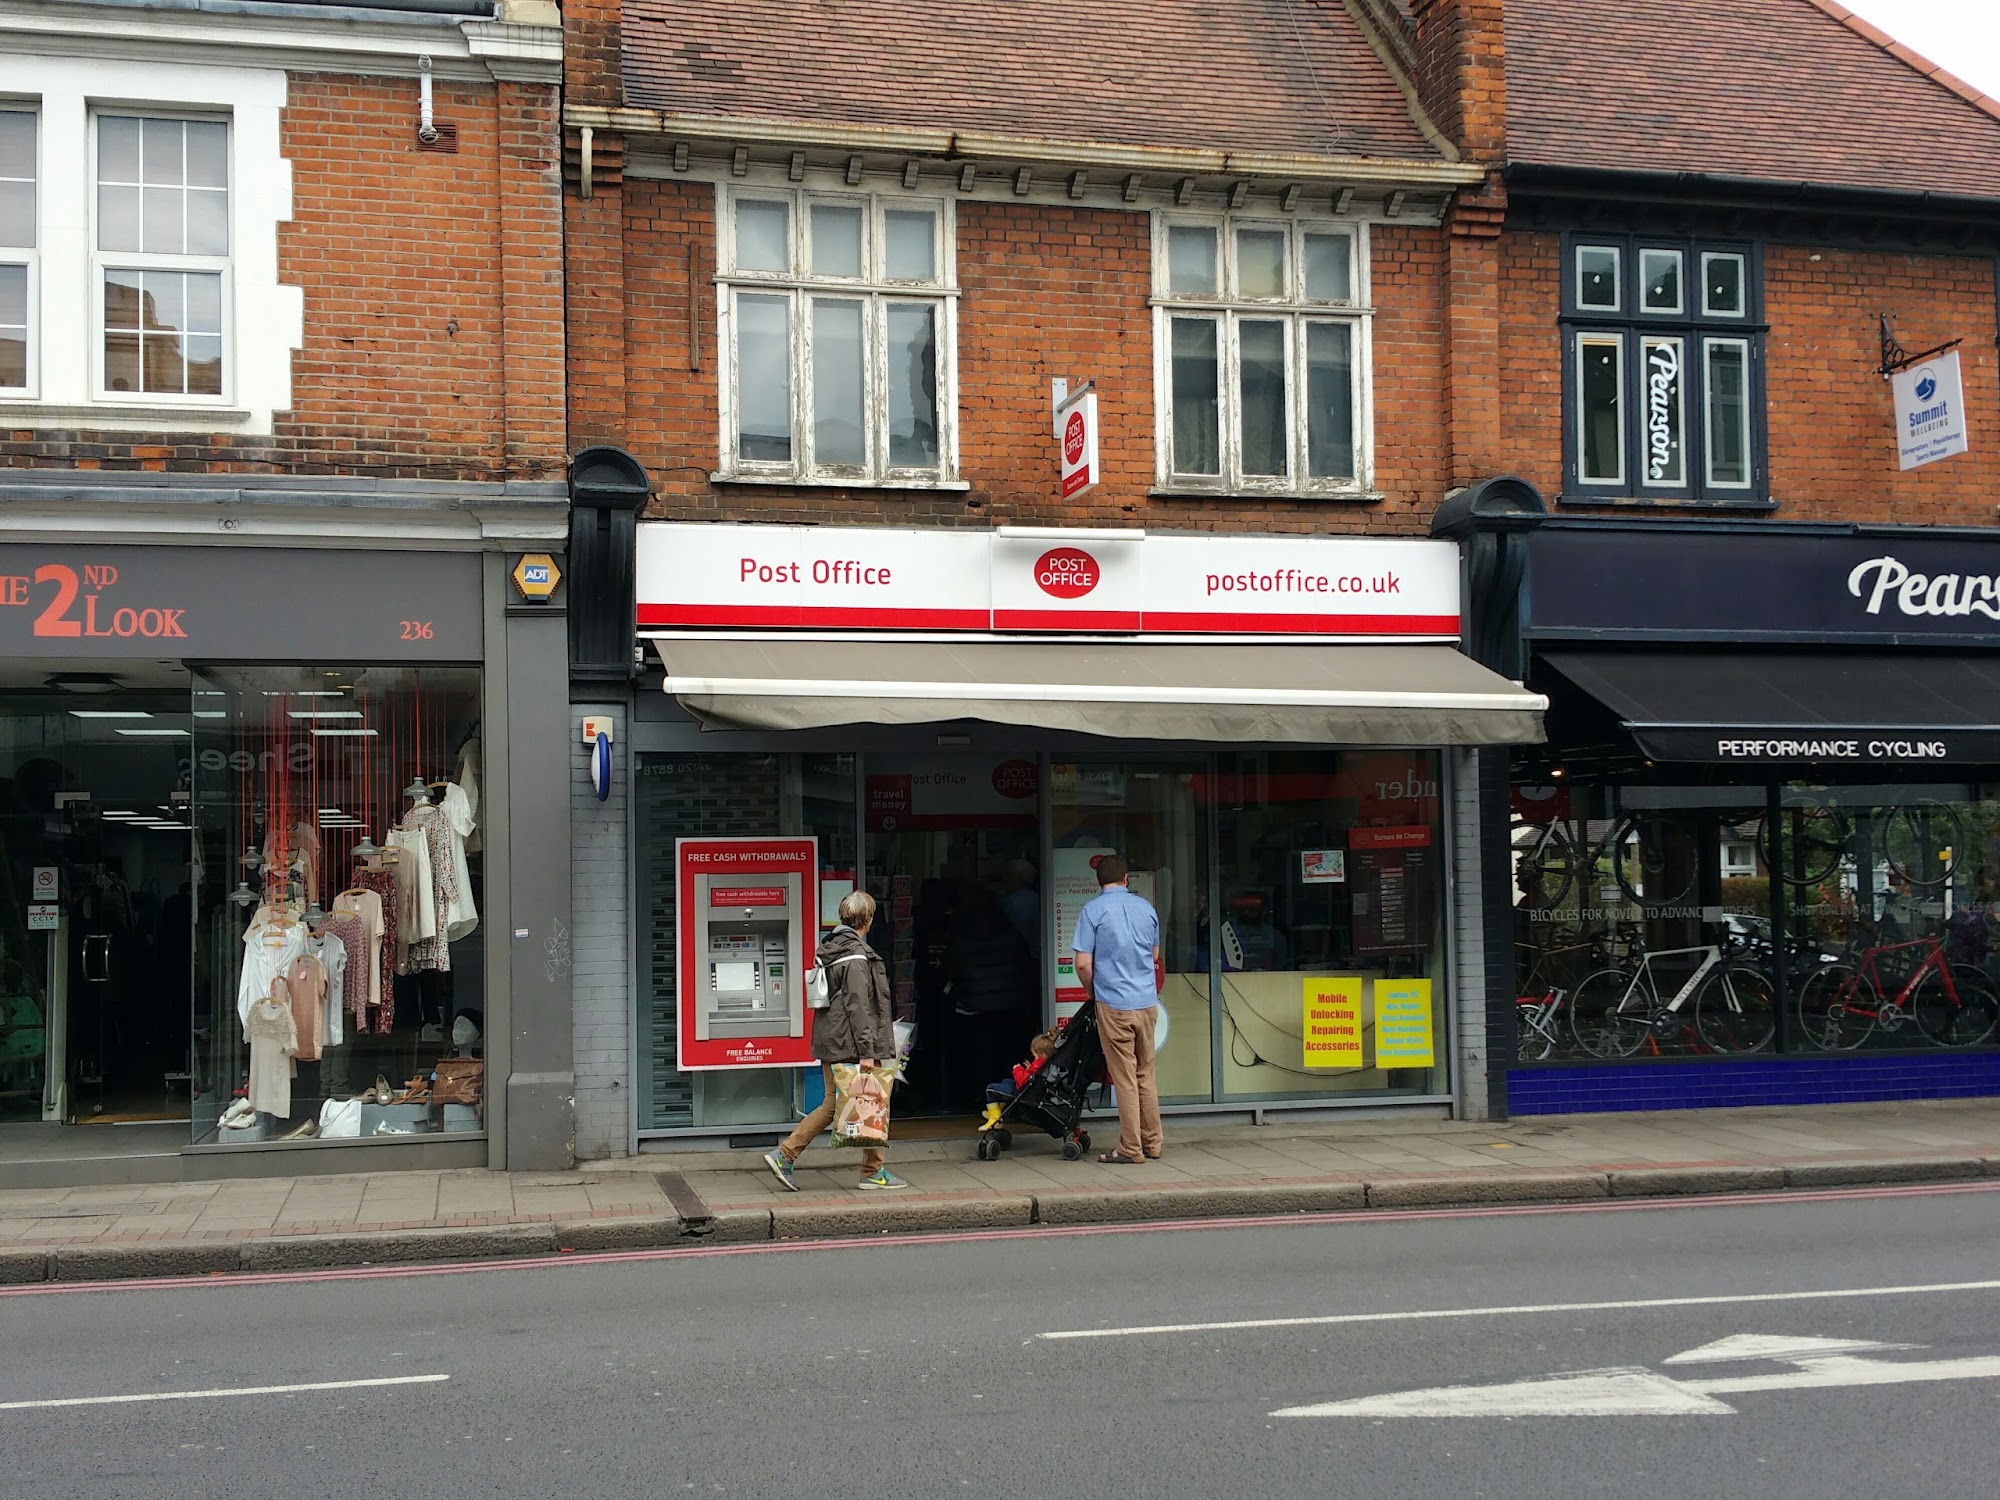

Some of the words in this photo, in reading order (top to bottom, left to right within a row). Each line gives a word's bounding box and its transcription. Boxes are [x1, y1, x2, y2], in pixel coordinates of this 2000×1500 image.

[1649, 343, 1678, 479] Pearson
[1909, 401, 1948, 427] Summit
[1068, 420, 1081, 440] POST
[1910, 418, 1949, 437] WELLBEING
[1066, 434, 1083, 455] OFFICE
[1049, 558, 1087, 571] POST
[525, 569, 548, 581] ADT
[741, 558, 800, 583] Post
[812, 559, 891, 584] Office
[1040, 572, 1092, 586] OFFICE
[1206, 569, 1400, 596] postoffice.co.uk
[84, 595, 188, 637] LOOK
[400, 621, 434, 640] 236
[1718, 740, 1860, 757] PERFORMANCE
[1868, 741, 1947, 757] CYCLING
[1003, 768, 1033, 778] POST
[906, 774, 930, 785] Post
[934, 774, 967, 784] Office
[997, 778, 1037, 789] OFFICE
[873, 789, 904, 799] travel
[871, 800, 906, 811] money
[1404, 832, 1425, 840] Change
[688, 853, 711, 862] FREE
[713, 853, 737, 861] CASH
[739, 852, 807, 861] WITHDRAWALS
[1530, 908, 1579, 922] BICYCLES
[1581, 907, 1602, 920] FOR
[1605, 907, 1643, 920] NOVI
[1646, 907, 1659, 919] TO
[1660, 907, 1703, 920] ADVANC
[1317, 994, 1347, 1004] Mobile
[1310, 1010, 1354, 1020] Unlocking
[1311, 1026, 1354, 1036] Repairing
[1305, 1041, 1360, 1051] Accessories
[726, 1049, 743, 1057] FREE
[744, 1048, 772, 1056] BALANCE
